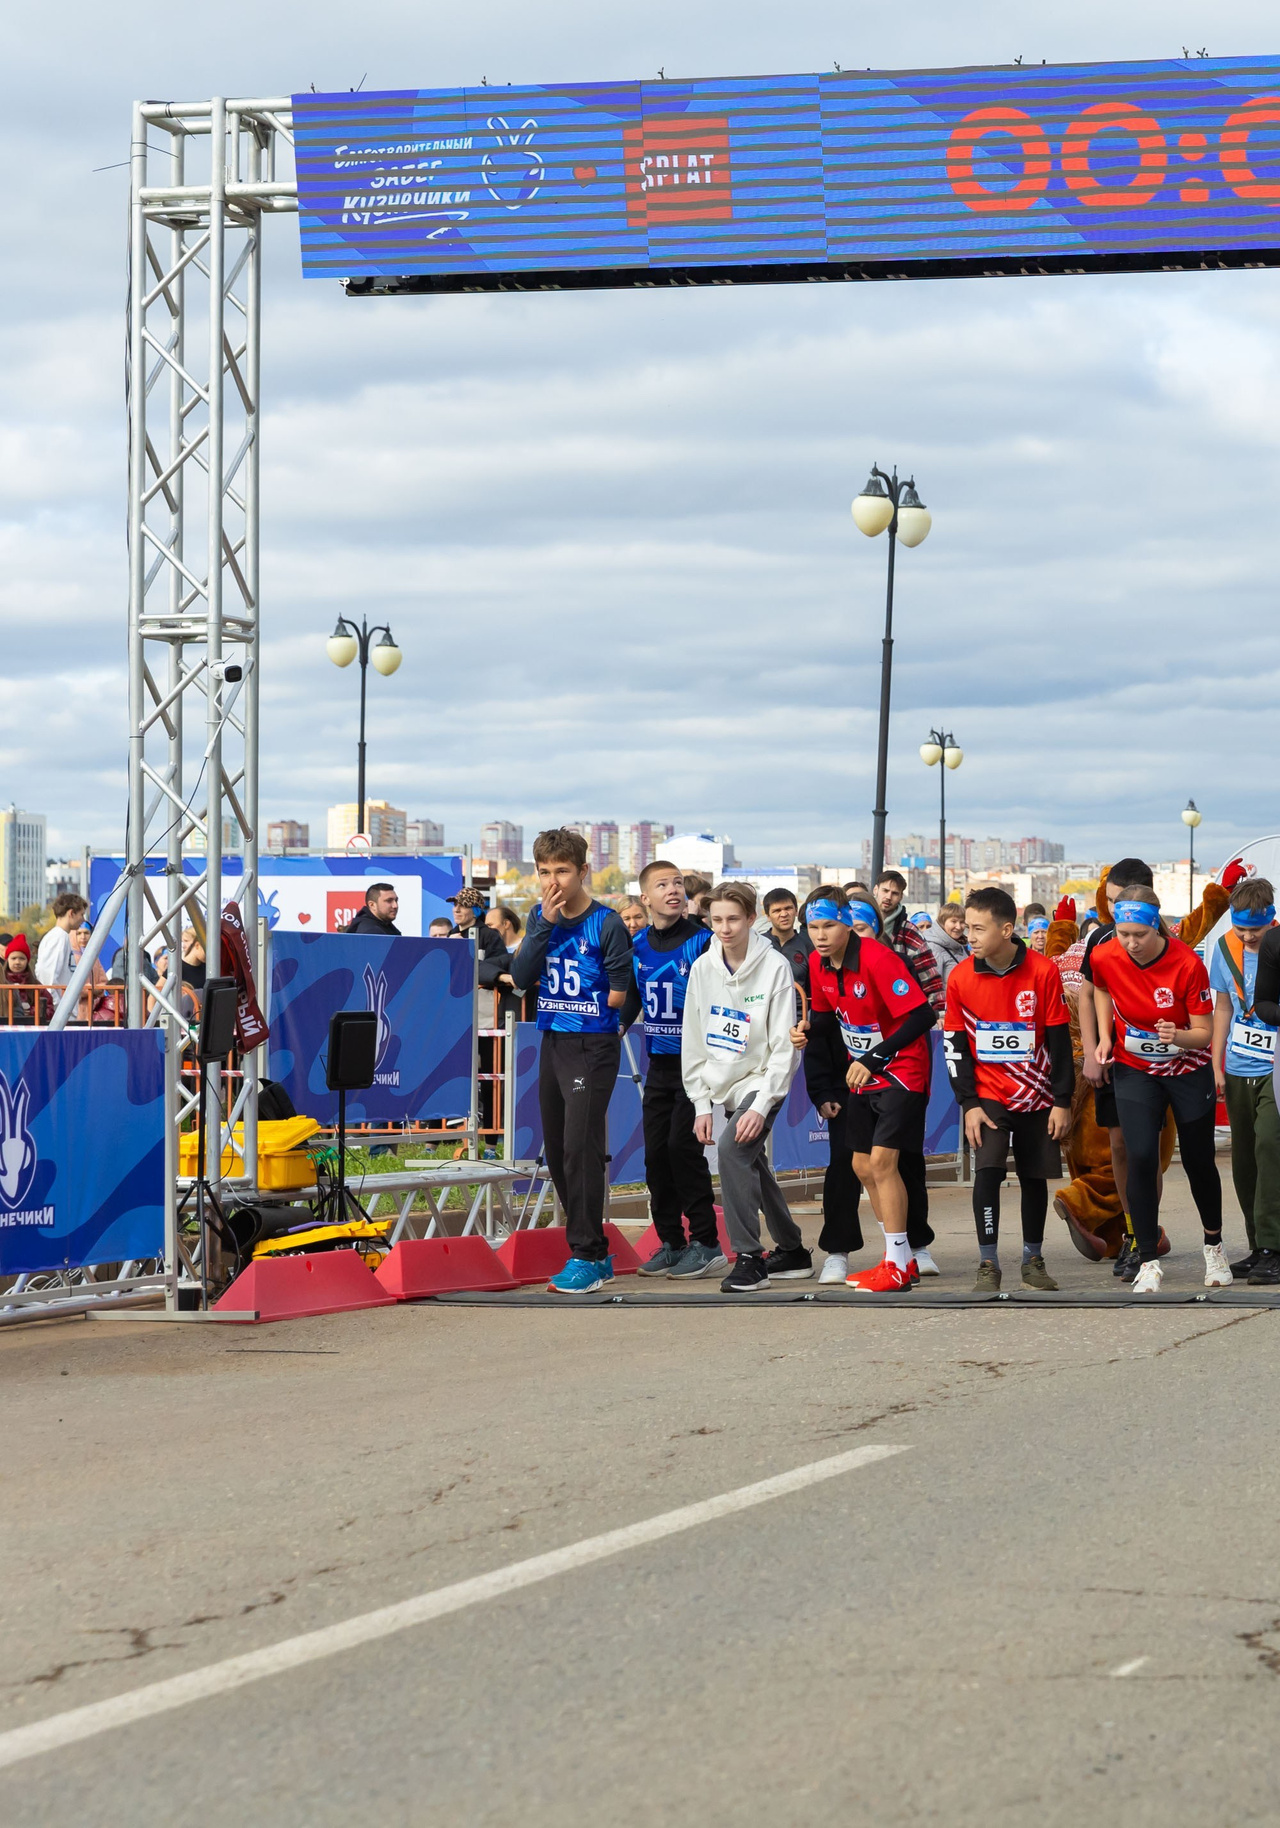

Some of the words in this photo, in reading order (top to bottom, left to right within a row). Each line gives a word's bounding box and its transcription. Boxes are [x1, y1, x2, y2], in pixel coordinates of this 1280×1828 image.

[545, 956, 581, 997] 55
[538, 999, 597, 1013] УЗНЕЧИКИ
[645, 981, 678, 1019] 51
[722, 1022, 740, 1038] 45
[846, 1034, 872, 1050] 157
[991, 1035, 1020, 1049] 56
[1140, 1042, 1169, 1053] 63
[1244, 1031, 1272, 1049] 121
[983, 1206, 994, 1235] NIKE
